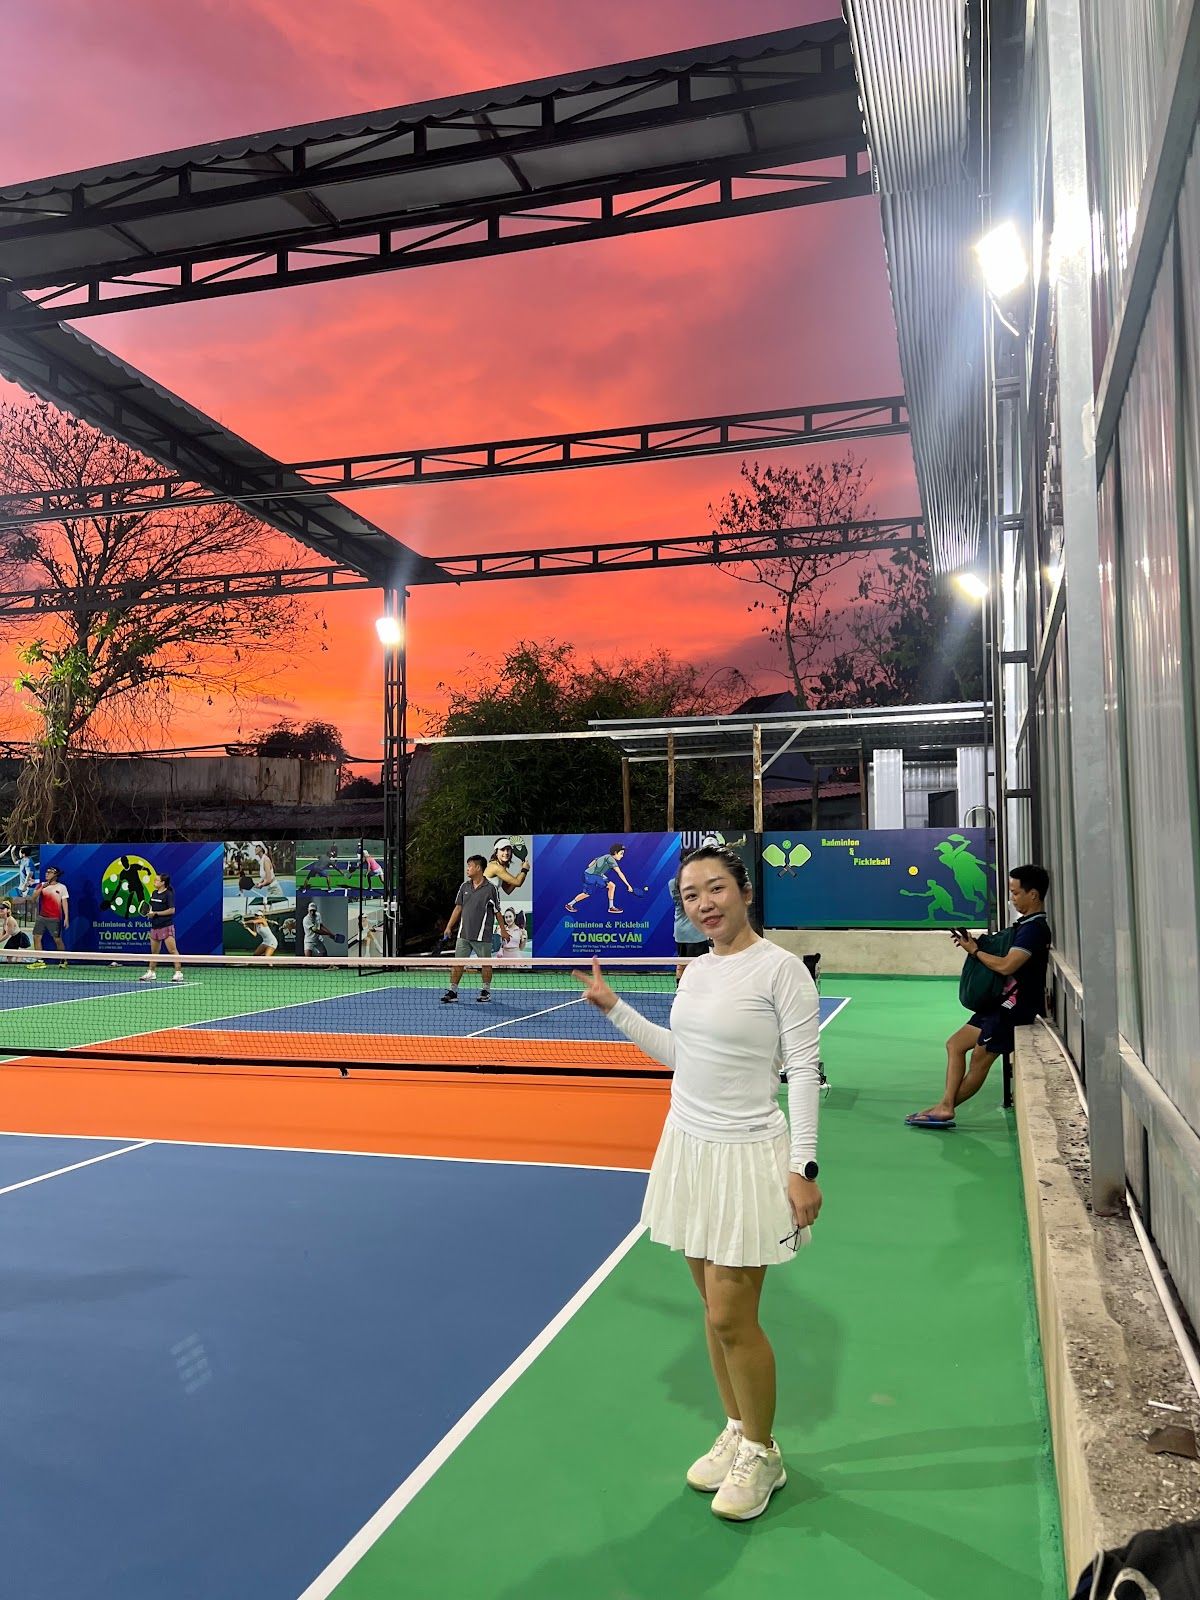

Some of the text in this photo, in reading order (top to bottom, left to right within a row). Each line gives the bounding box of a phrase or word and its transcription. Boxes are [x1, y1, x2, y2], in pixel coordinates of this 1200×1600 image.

[821, 838, 860, 847] Badminton
[848, 847, 855, 856] &
[564, 921, 650, 929] Badminton & Pickleball
[98, 930, 111, 940] TÔ
[112, 931, 138, 942] NGỌC
[571, 931, 643, 944] TÔ NGỌC VÂN
